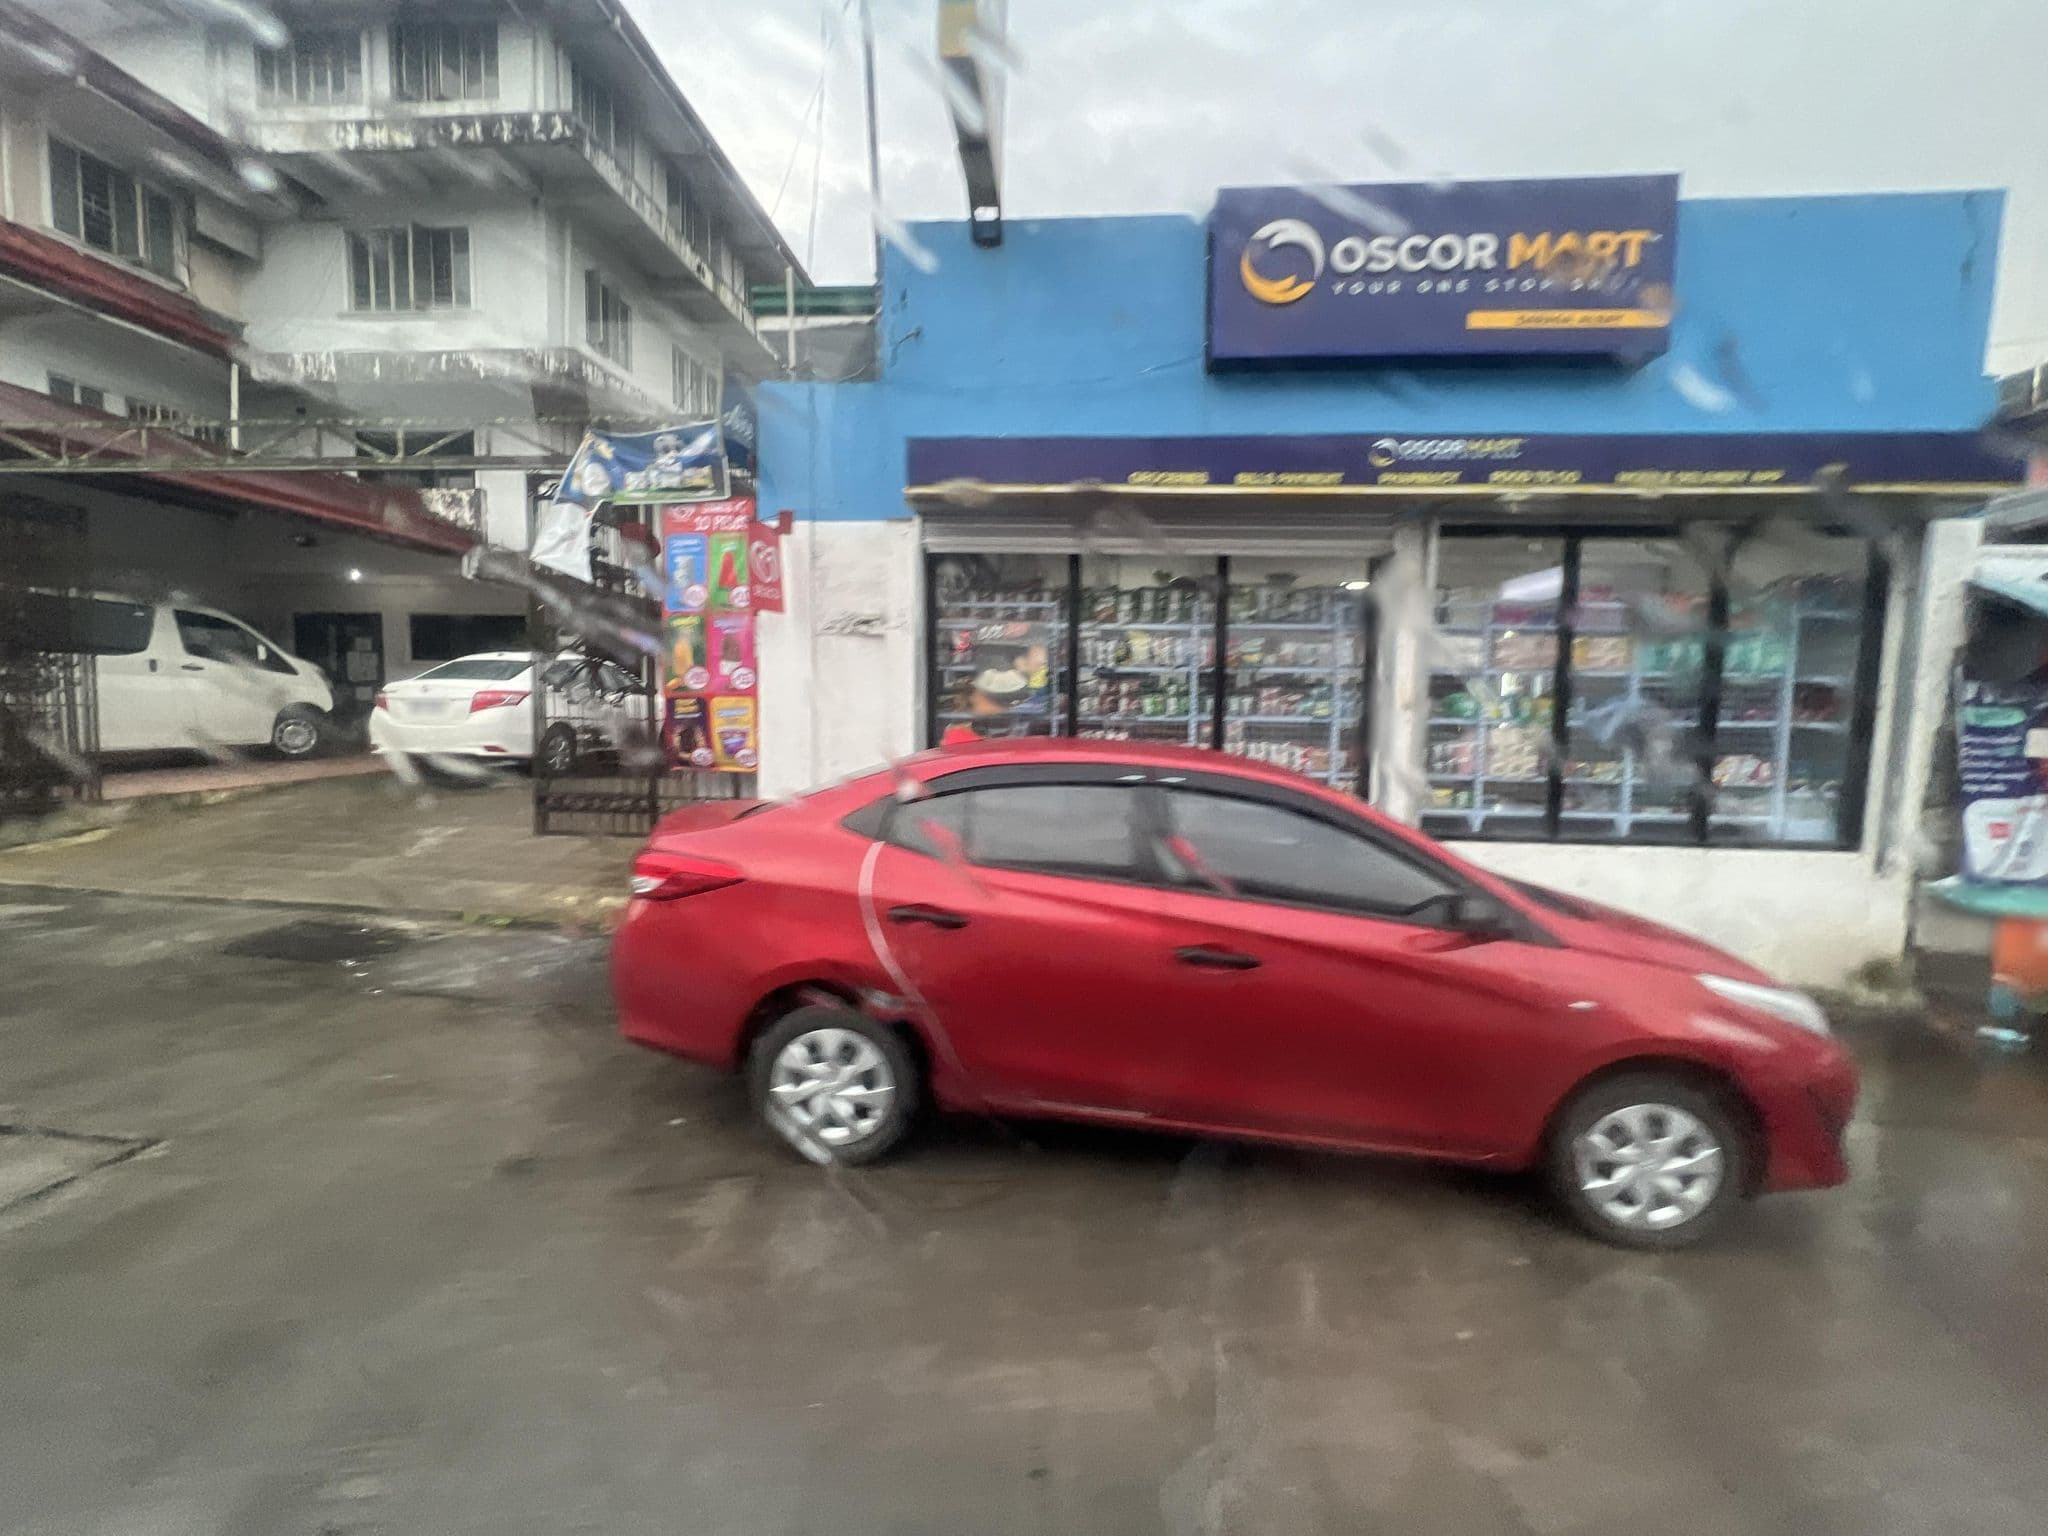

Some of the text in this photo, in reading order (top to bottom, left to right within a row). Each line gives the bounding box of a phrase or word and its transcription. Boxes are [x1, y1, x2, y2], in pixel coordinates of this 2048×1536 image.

[1330, 232, 1499, 273] OSCOR
[1331, 279, 1402, 295] YOUR
[1415, 279, 1471, 295] ONE
